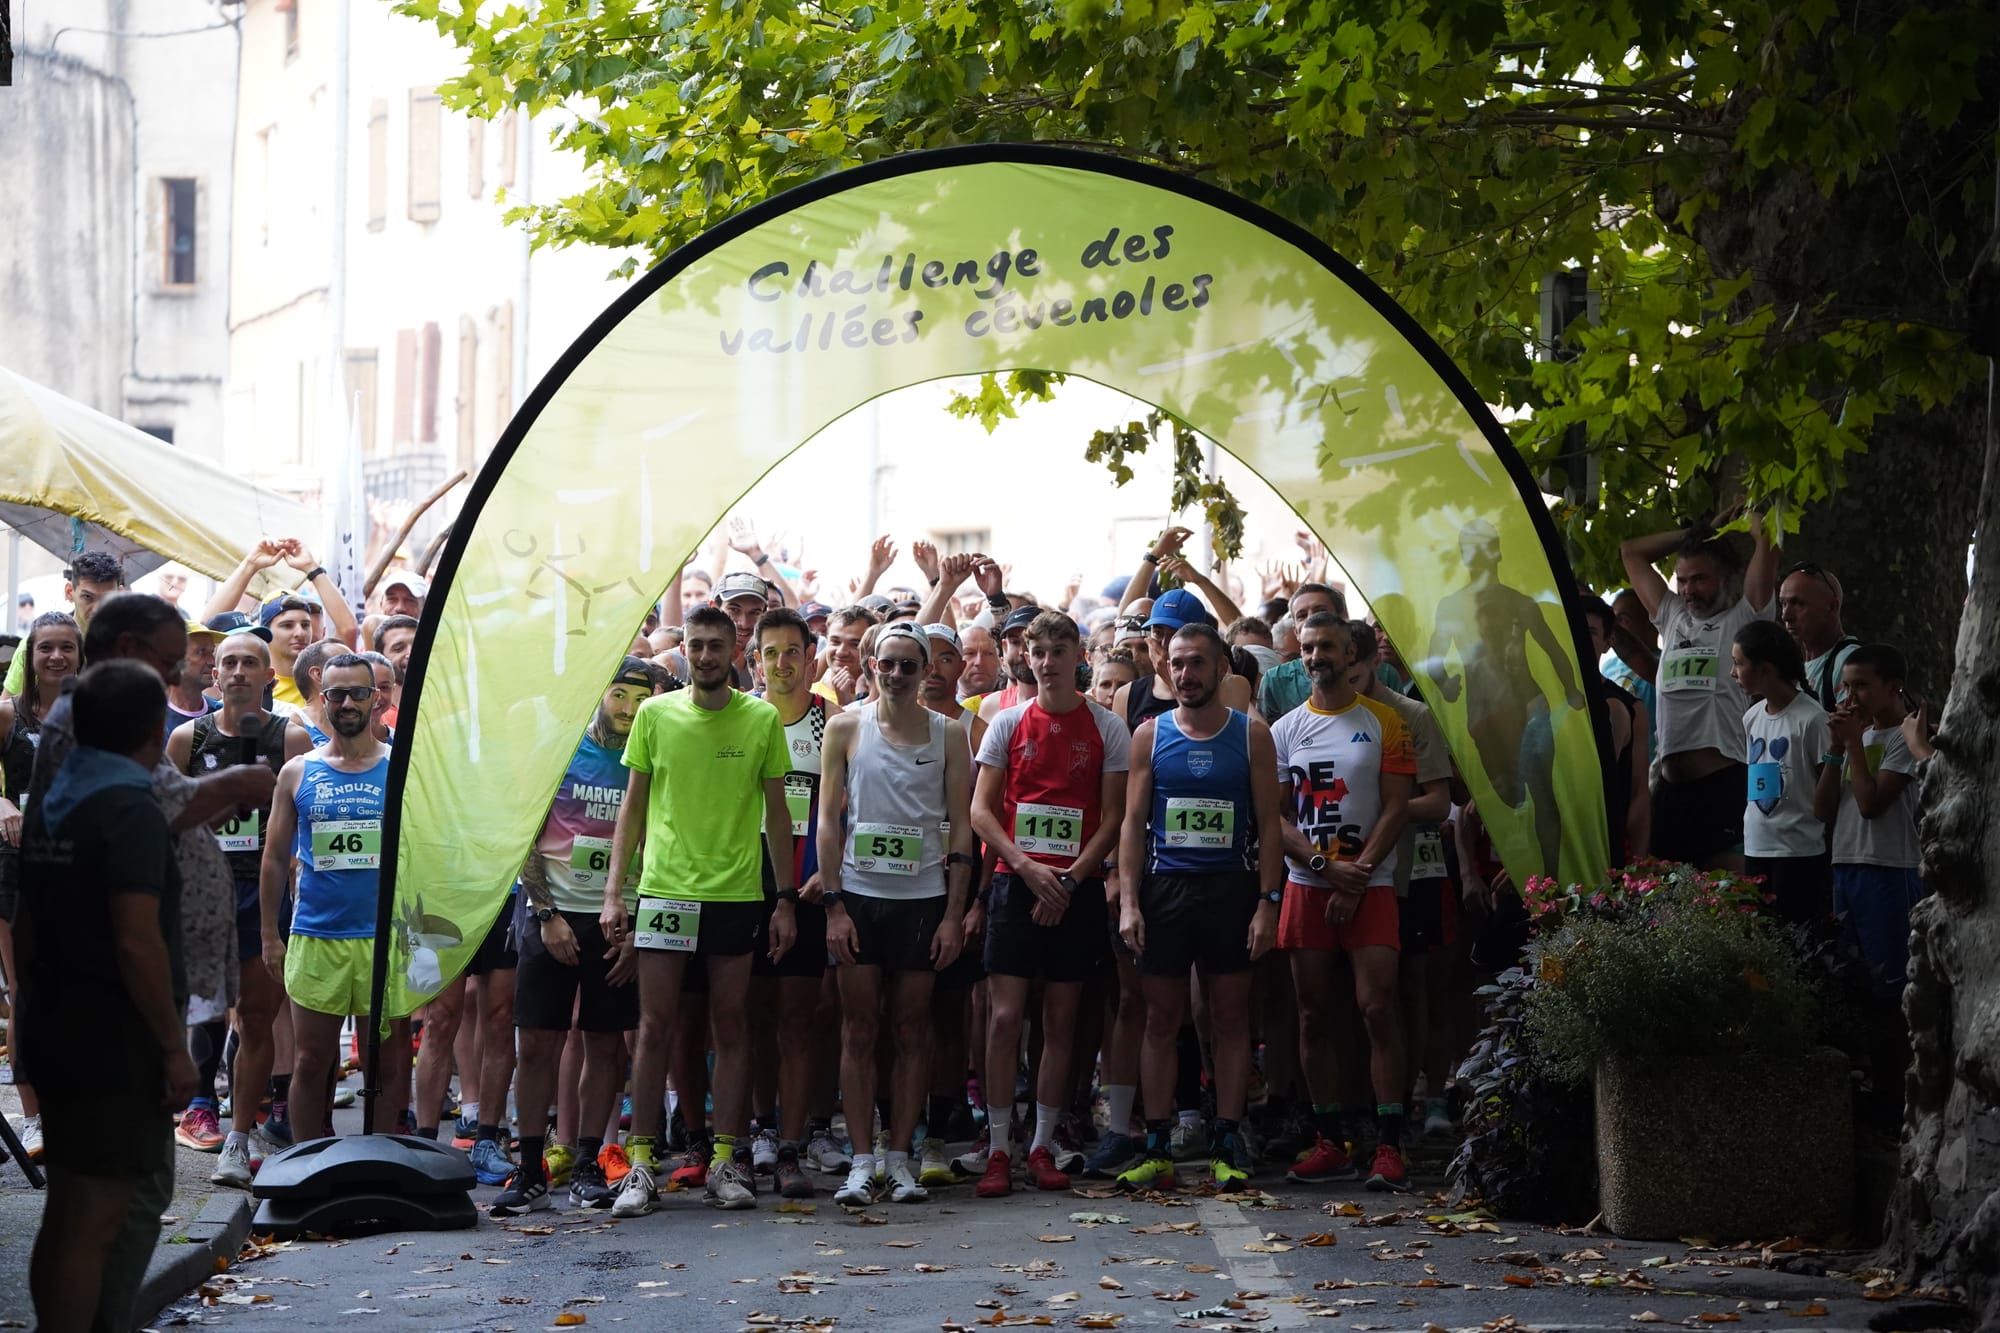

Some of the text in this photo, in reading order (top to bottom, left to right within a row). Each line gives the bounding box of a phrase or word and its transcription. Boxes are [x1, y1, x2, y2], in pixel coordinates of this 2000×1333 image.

[747, 224, 1175, 299] Challenge des
[720, 273, 1214, 356] vallées cévenoles
[1670, 658, 1710, 678] 117
[1757, 778, 1766, 791] 5
[1025, 816, 1072, 840] 113
[1176, 810, 1224, 832] 134
[329, 833, 363, 854] 46
[871, 836, 904, 858] 53
[1418, 843, 1438, 862] 61
[648, 912, 681, 934] 43
